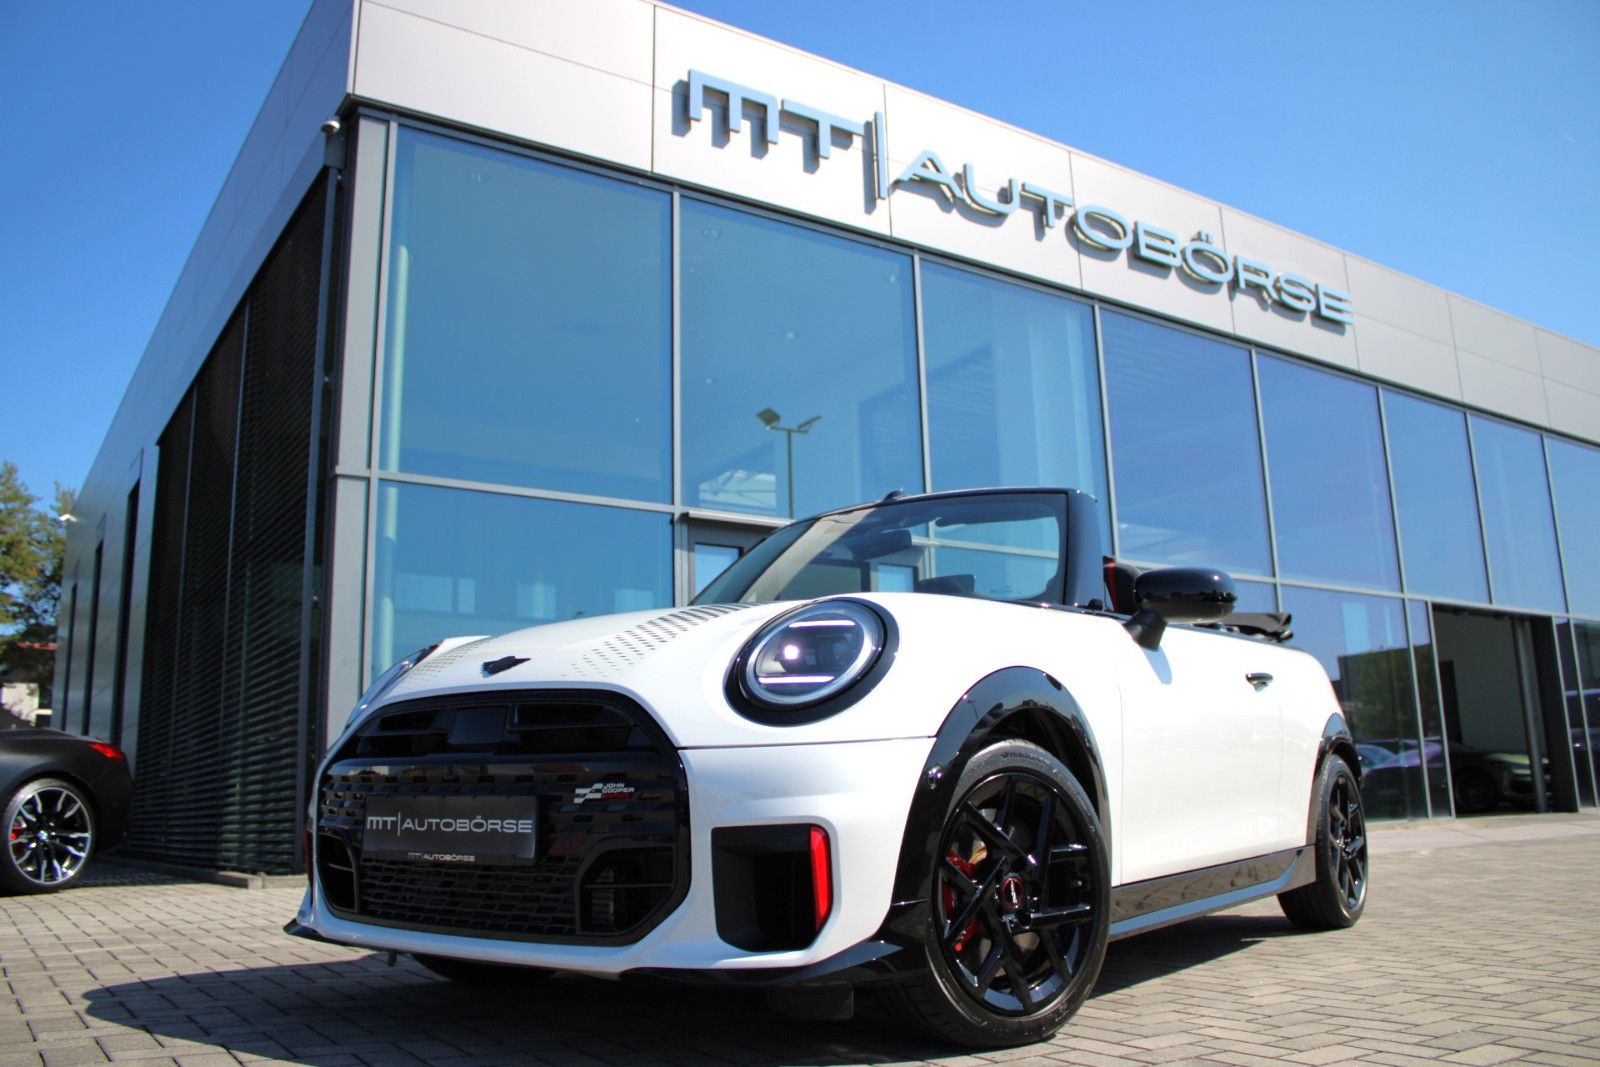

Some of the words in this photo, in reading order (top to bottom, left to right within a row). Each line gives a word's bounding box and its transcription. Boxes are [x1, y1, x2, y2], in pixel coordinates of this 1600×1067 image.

[687, 68, 865, 160] MT
[898, 149, 1356, 326] AUTOBÖRSE
[366, 815, 398, 831] MT
[401, 815, 534, 834] AUTOBÖRSE
